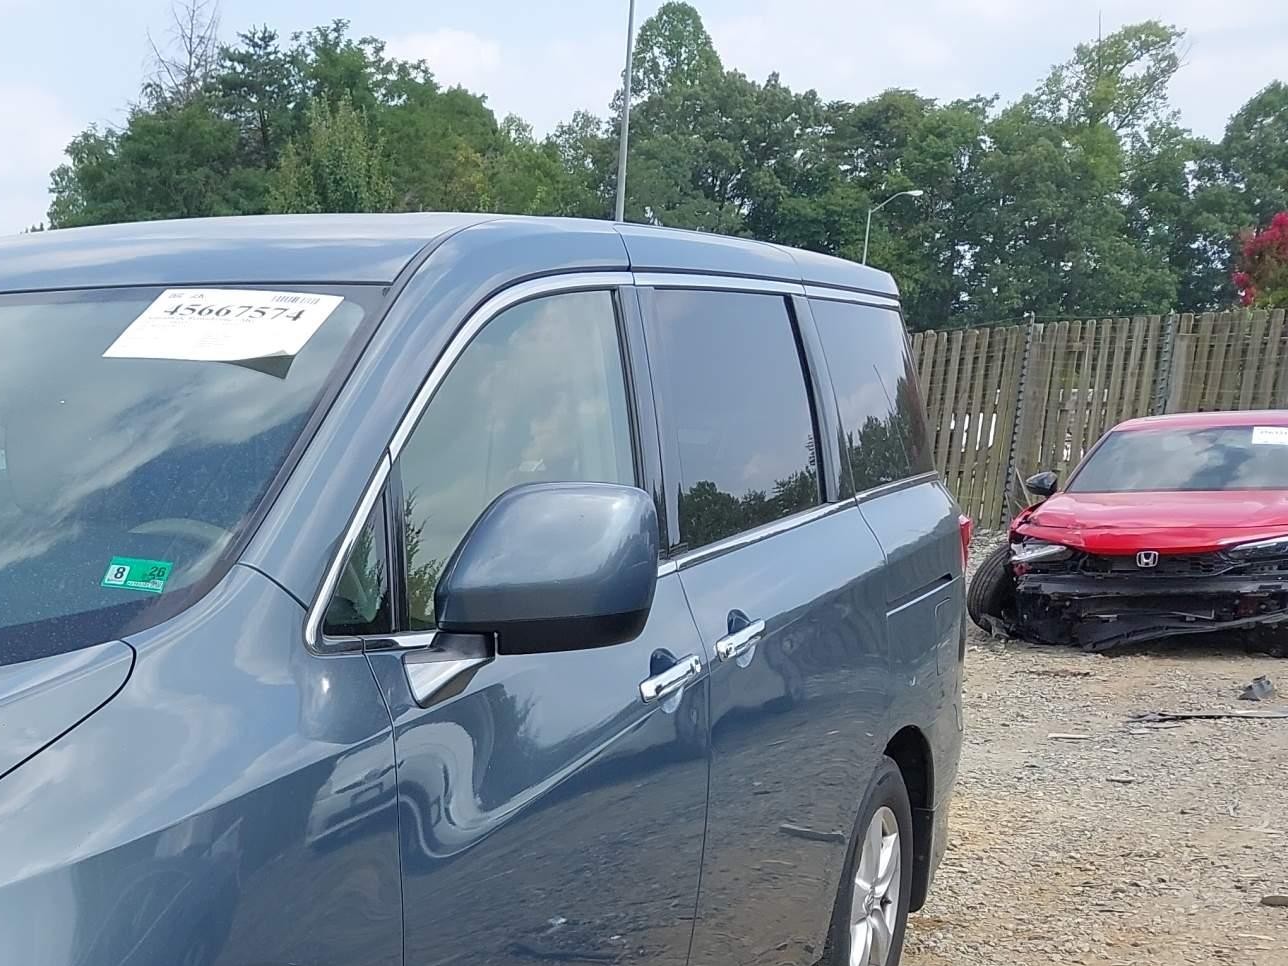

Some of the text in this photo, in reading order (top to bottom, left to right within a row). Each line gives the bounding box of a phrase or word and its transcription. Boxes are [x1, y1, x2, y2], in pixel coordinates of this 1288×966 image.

[164, 303, 306, 322] 45667574
[114, 566, 167, 579] 8 26
